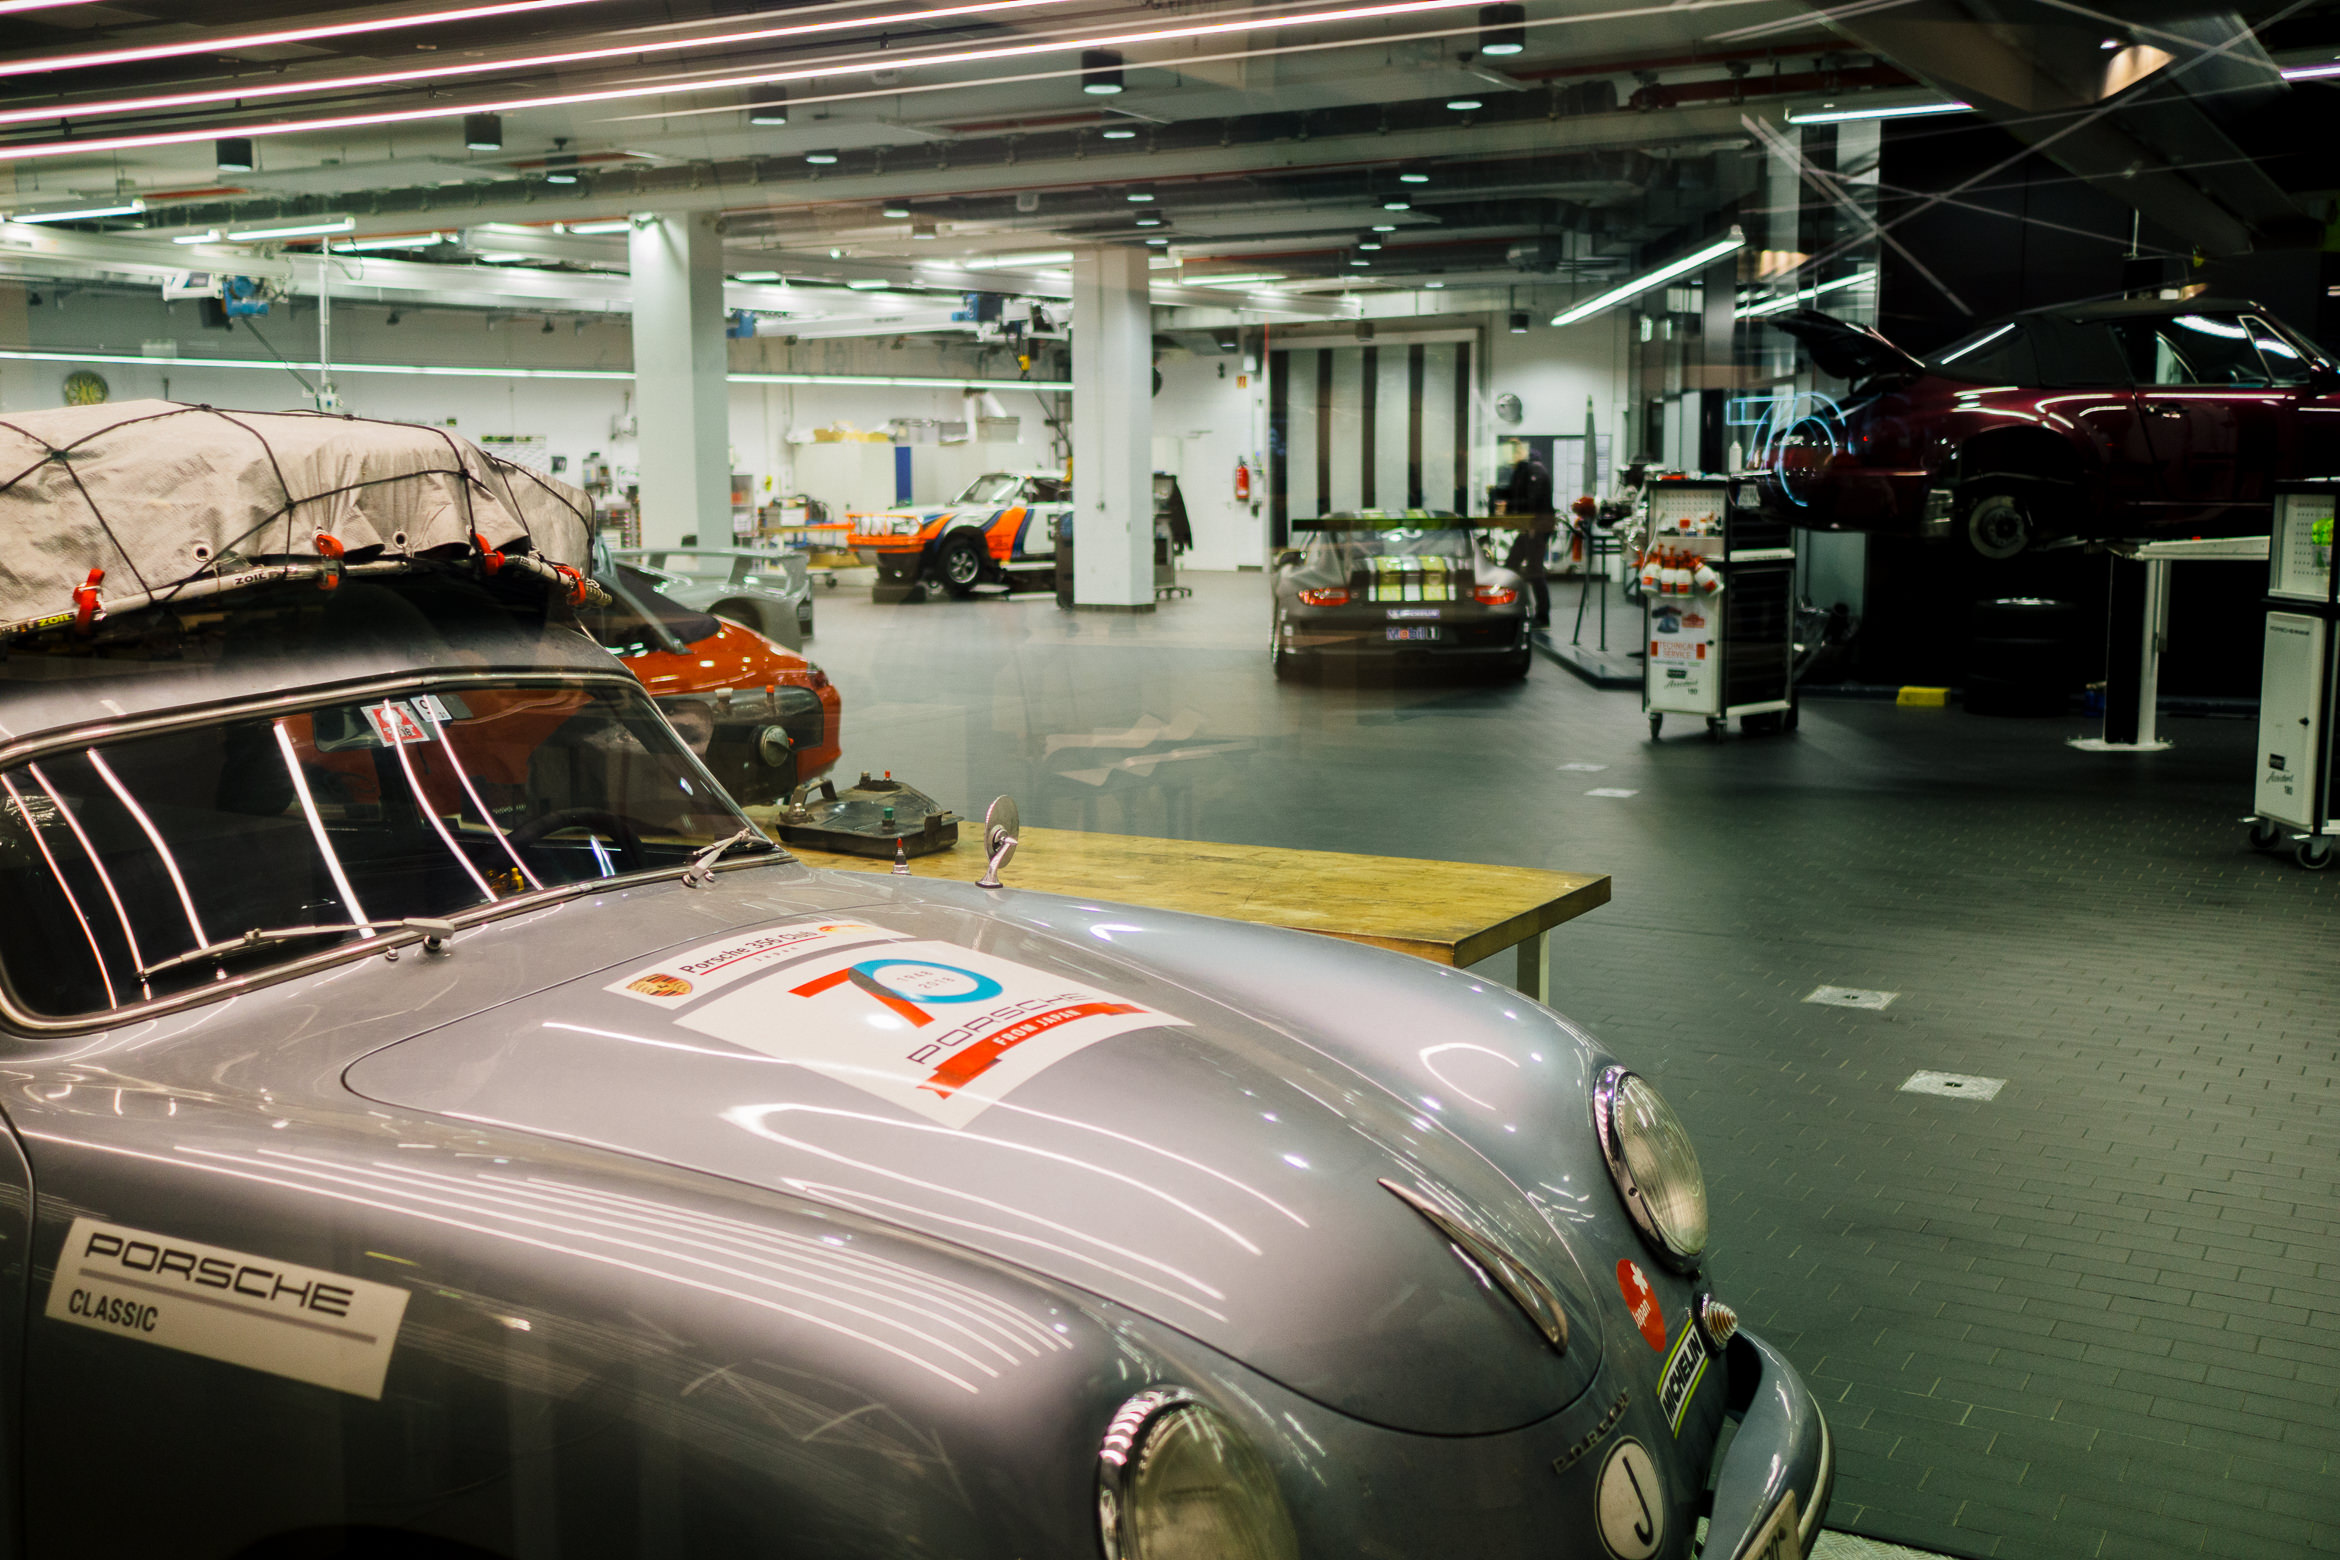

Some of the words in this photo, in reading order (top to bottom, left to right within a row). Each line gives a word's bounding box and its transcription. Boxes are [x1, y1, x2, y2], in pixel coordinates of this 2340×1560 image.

[234, 572, 267, 585] ZOIL
[38, 614, 73, 627] ZOIL
[1387, 626, 1425, 640] Mobil
[678, 947, 751, 974] Porsche
[745, 937, 783, 949] 356
[907, 992, 1094, 1065] PORSCHE
[992, 1023, 1039, 1046] FROM
[1036, 1009, 1082, 1027] JAPAN
[83, 1232, 355, 1318] PORSCHE
[68, 1288, 159, 1333] CLASSIC
[1631, 1299, 1652, 1330] Japan
[1661, 1332, 1704, 1423] MICHELIN
[1622, 1456, 1654, 1547] J
